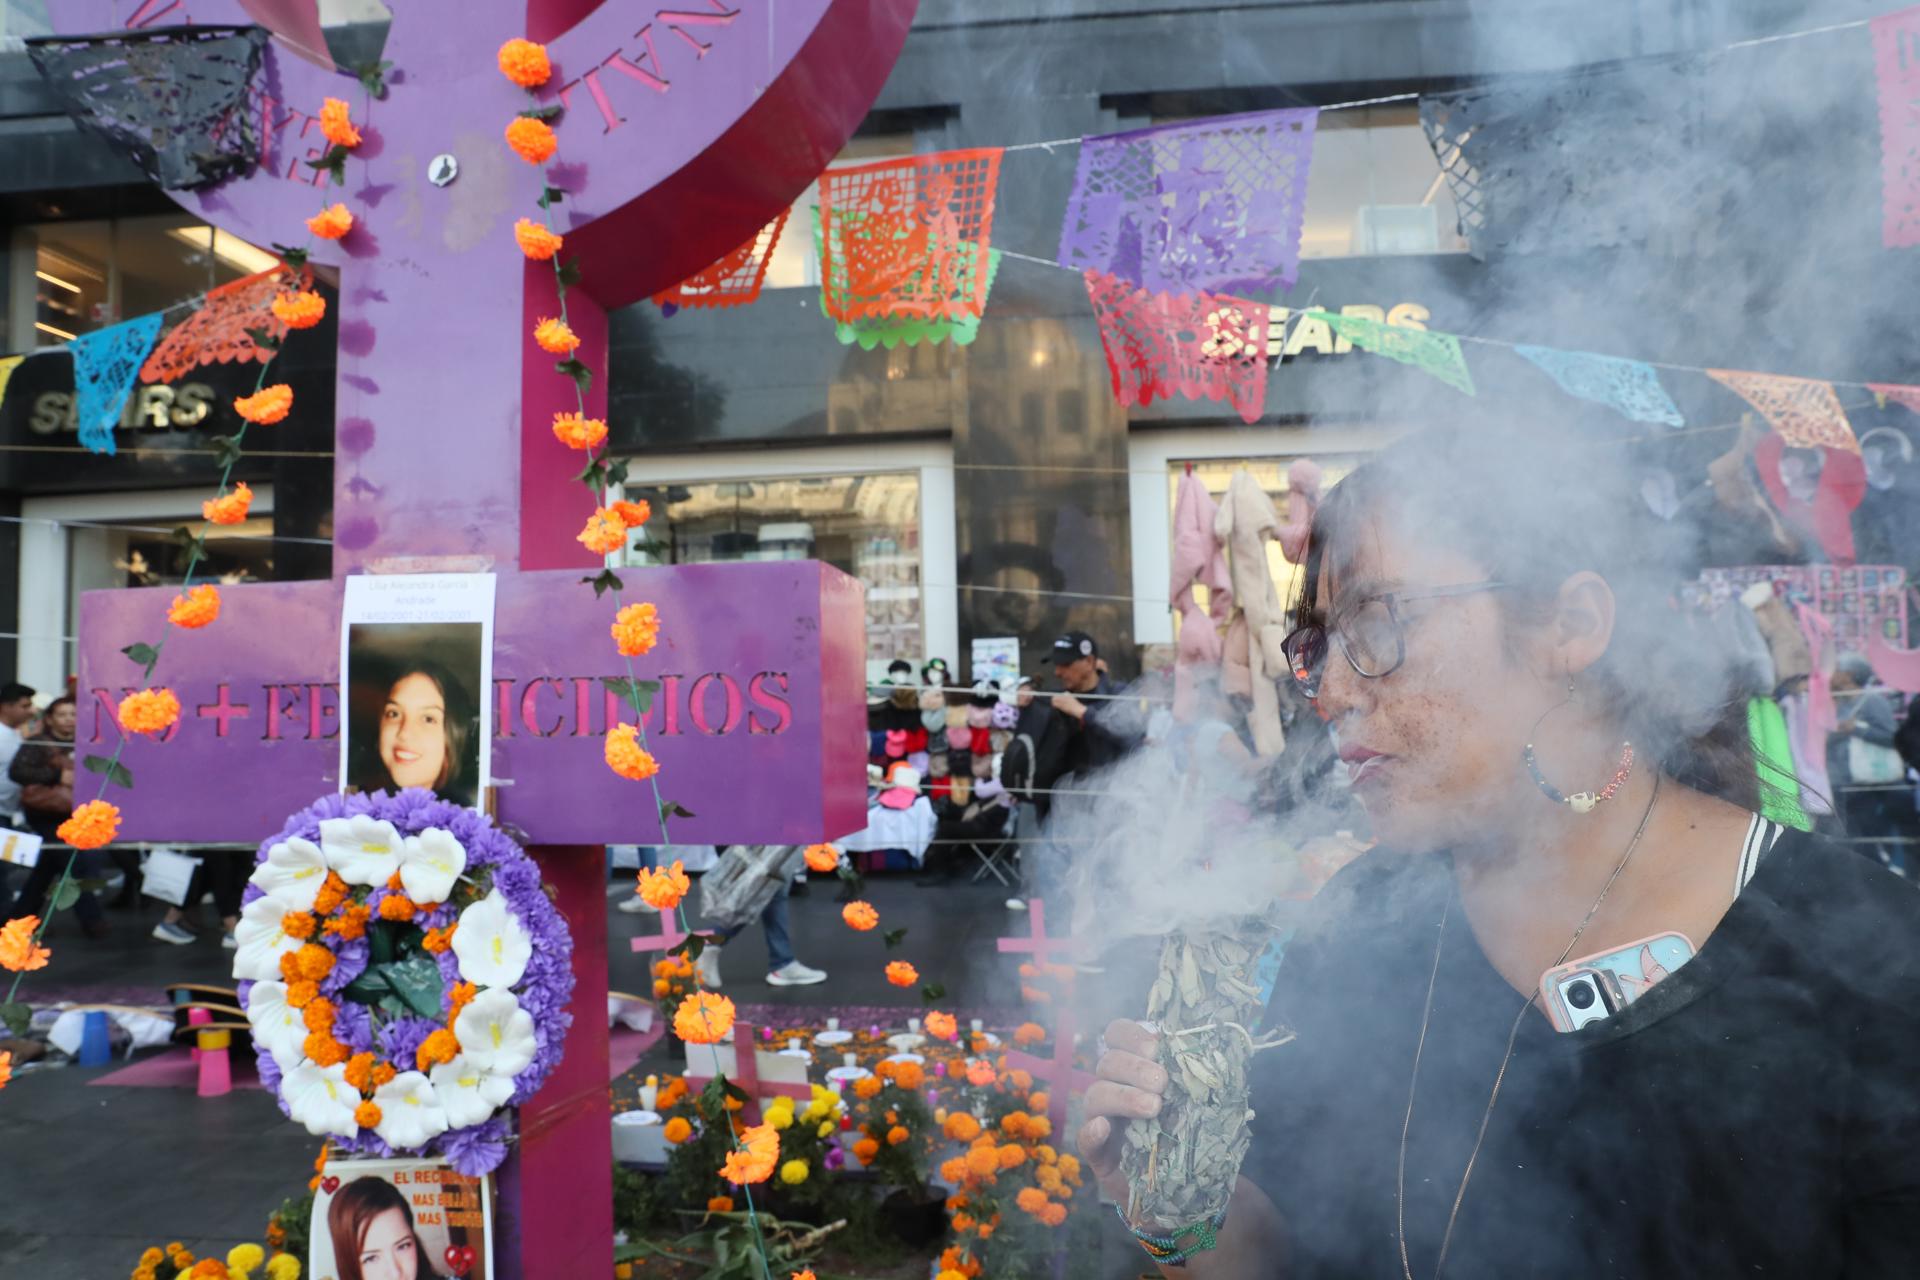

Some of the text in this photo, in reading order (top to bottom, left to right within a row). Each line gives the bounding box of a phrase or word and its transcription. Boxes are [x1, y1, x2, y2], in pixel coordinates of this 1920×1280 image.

[29, 383, 216, 435] SRS
[394, 1171, 410, 1184] EL
[413, 1193, 435, 1206] MAS
[417, 1212, 442, 1225] MAS
